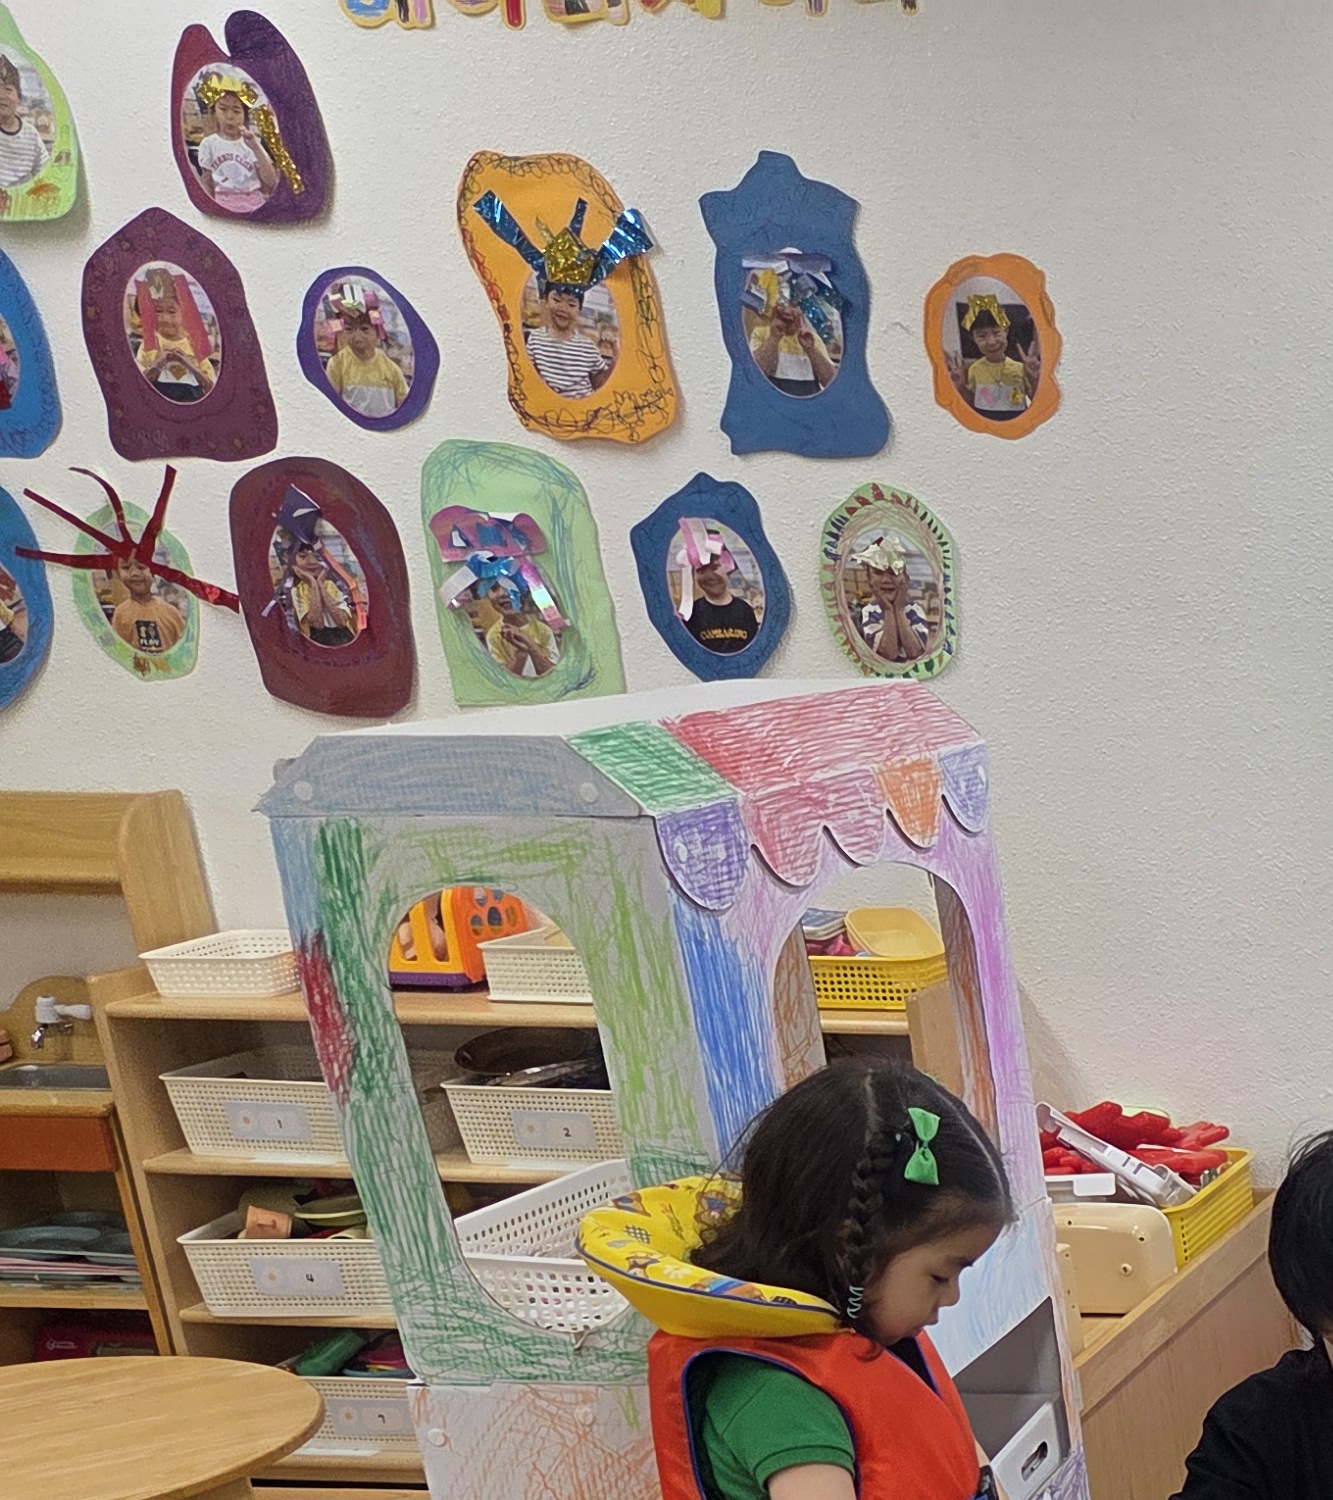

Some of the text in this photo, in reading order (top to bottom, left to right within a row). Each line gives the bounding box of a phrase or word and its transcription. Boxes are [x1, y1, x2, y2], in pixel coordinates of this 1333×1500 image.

[276, 1119, 283, 1129] 1
[563, 1127, 572, 1137] 2
[305, 1273, 314, 1283] 4
[378, 1413, 386, 1424] 7
